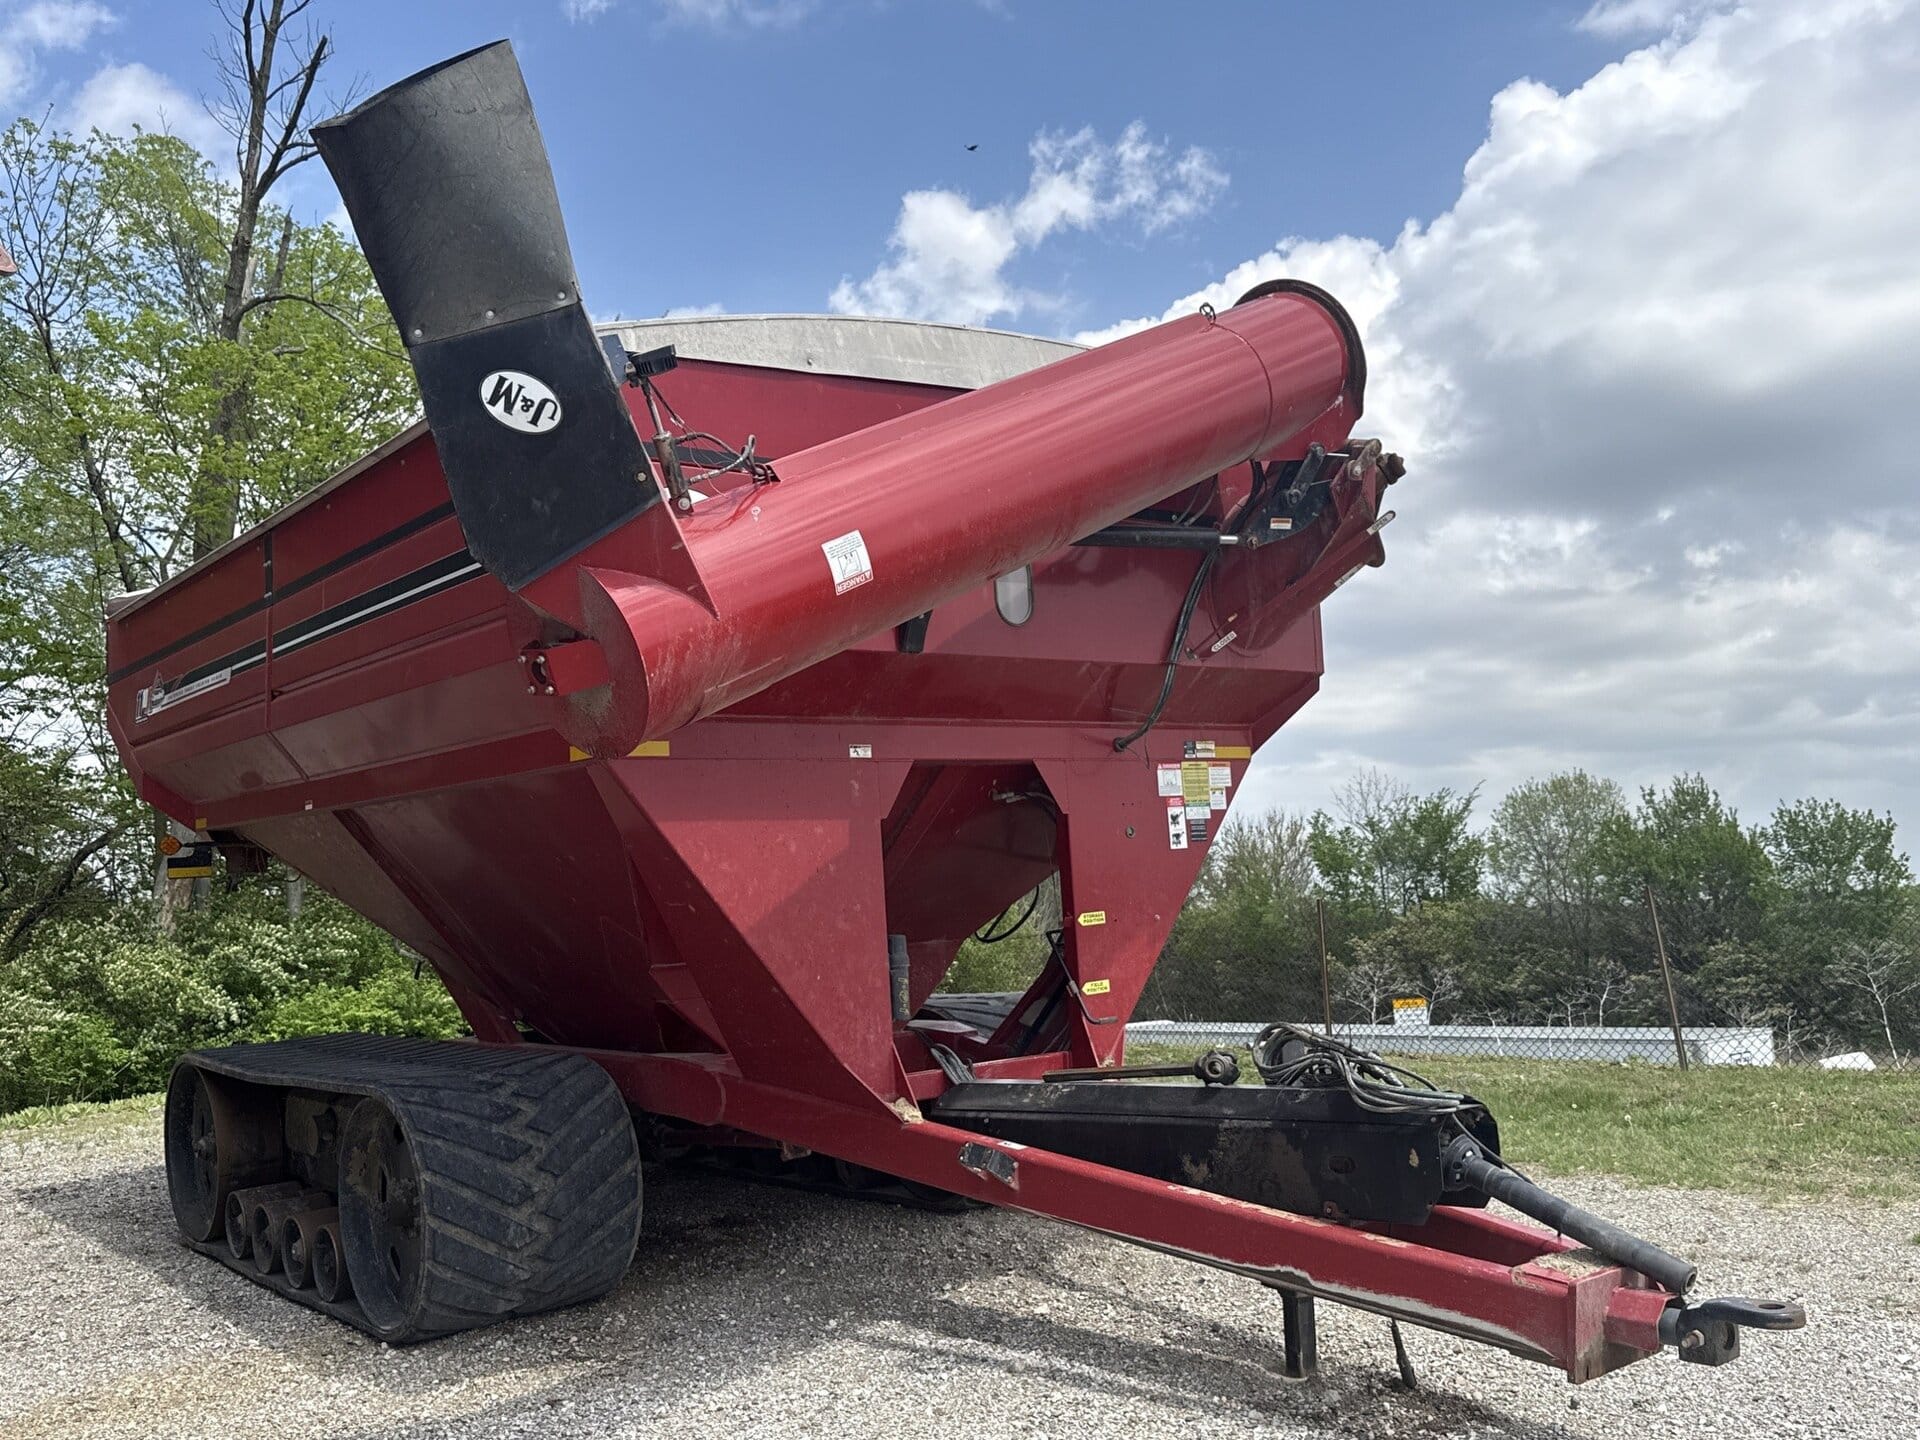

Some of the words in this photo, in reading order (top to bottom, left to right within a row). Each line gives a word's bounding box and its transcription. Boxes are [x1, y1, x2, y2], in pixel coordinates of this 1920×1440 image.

[486, 374, 559, 428] J&M
[1371, 516, 1390, 532] OPEN
[836, 572, 866, 593] DANGER
[1212, 632, 1236, 652] CLOSED
